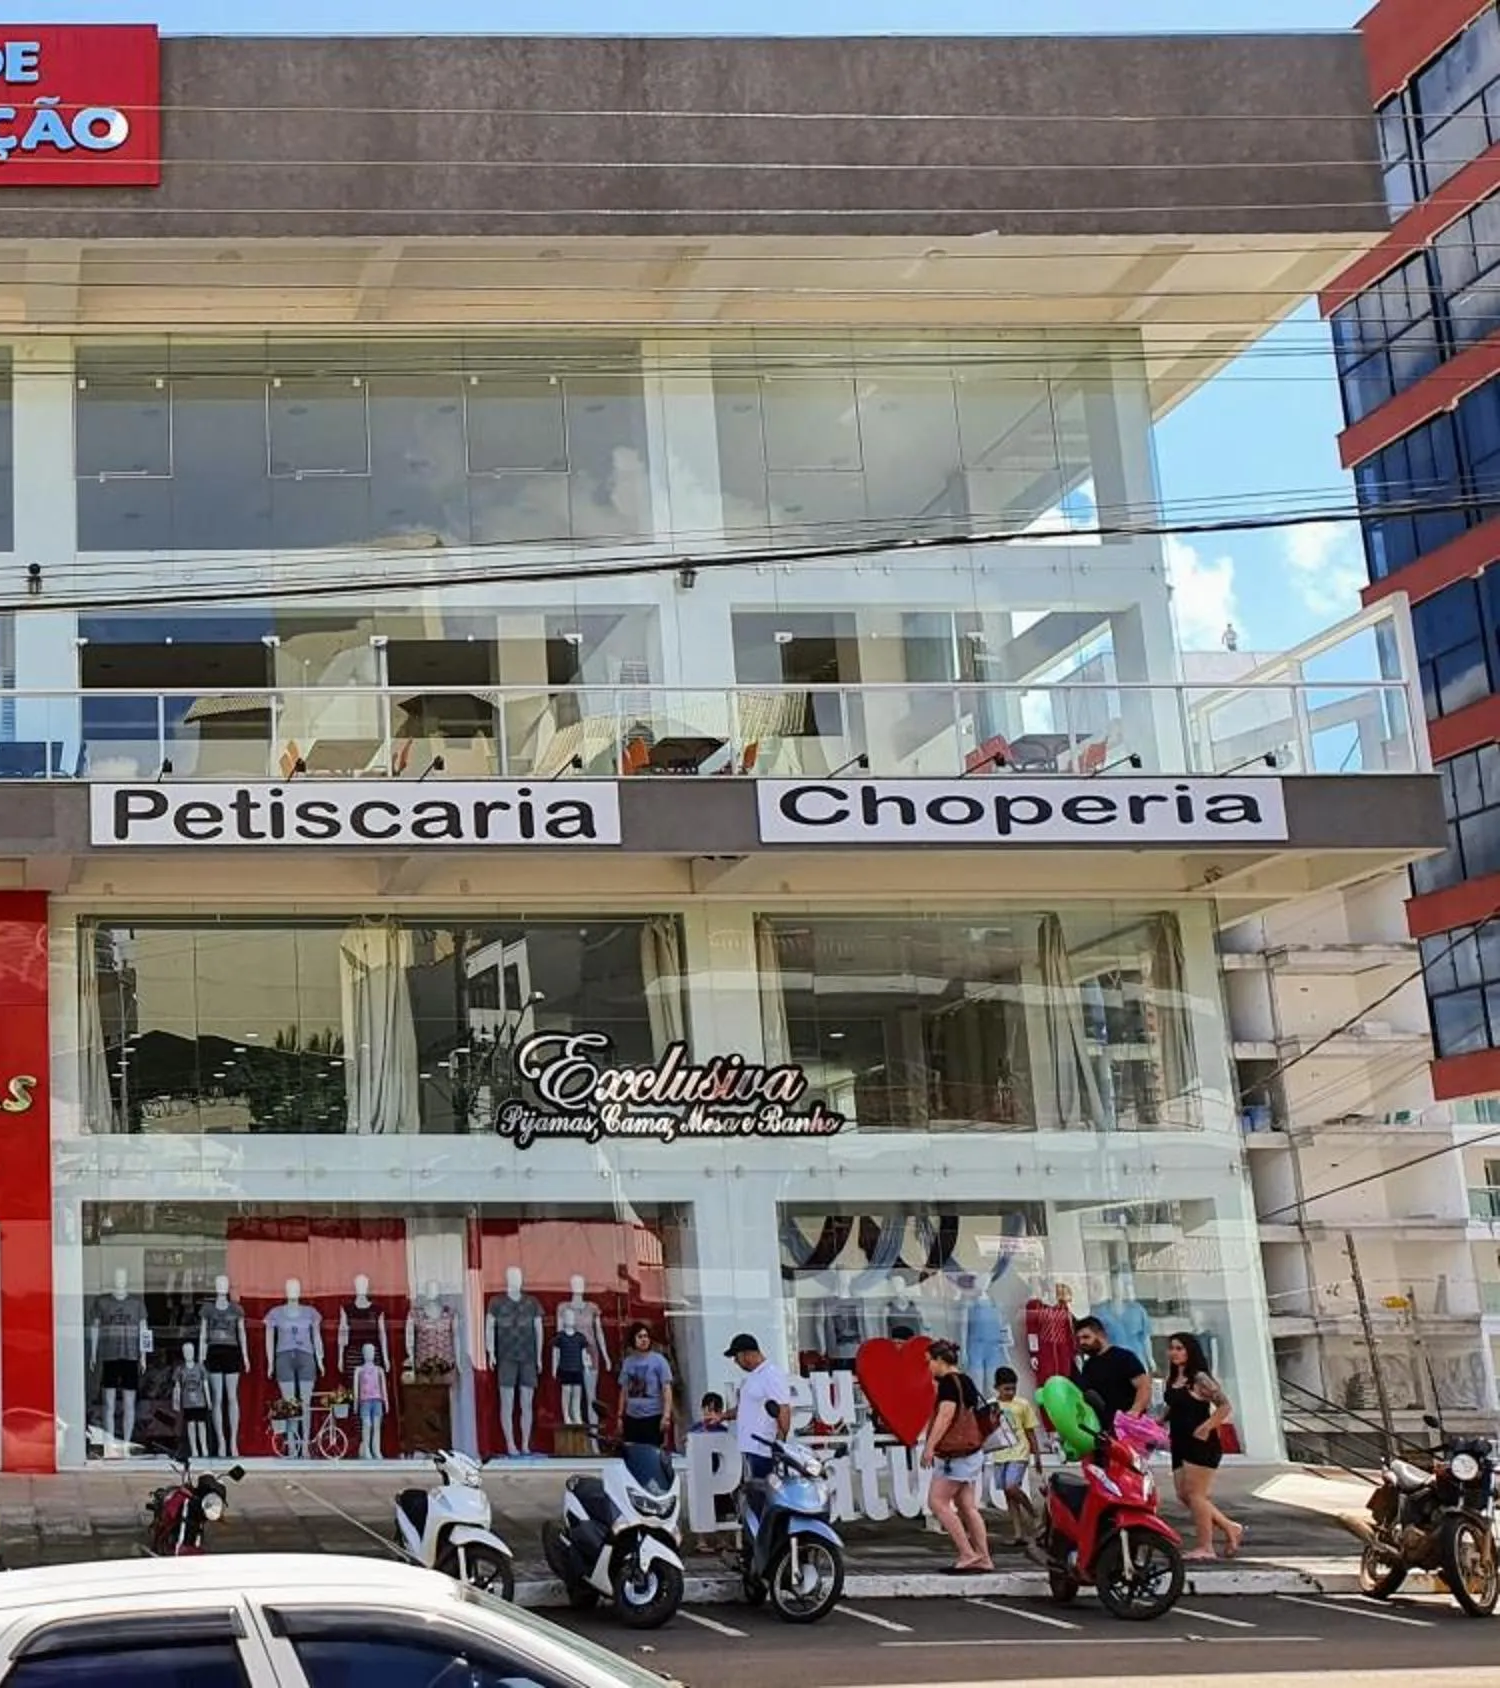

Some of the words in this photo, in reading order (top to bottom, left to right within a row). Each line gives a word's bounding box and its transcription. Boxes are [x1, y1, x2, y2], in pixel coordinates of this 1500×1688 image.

[112, 787, 598, 840] Petiscaria
[778, 784, 1263, 836] Choperia
[518, 1032, 807, 1109] Exclusiva
[680, 1105, 740, 1133] Mesa
[741, 1115, 755, 1133] e
[757, 1101, 843, 1133] Banho
